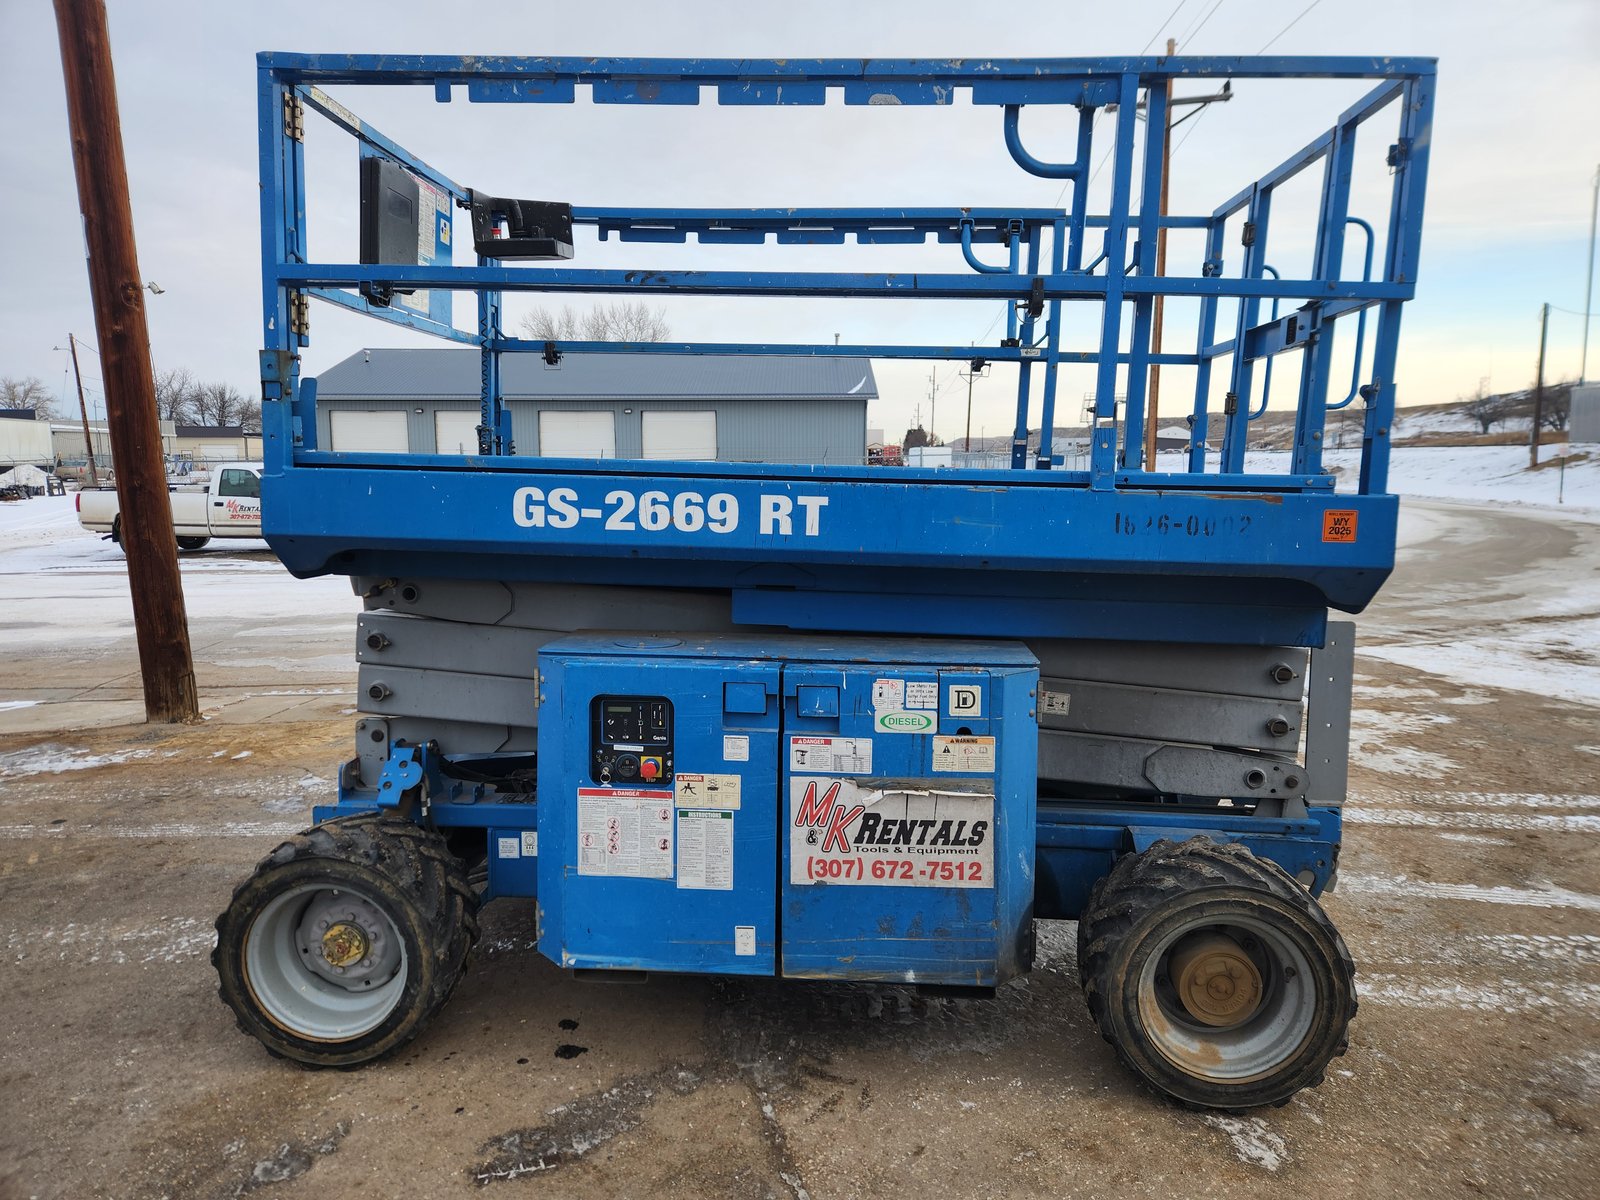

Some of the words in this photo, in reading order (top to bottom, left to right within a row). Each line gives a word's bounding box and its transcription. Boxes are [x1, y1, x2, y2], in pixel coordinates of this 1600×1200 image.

[512, 486, 740, 534] GS-2669
[758, 494, 830, 536] RT
[1333, 517, 1350, 526] WY
[1328, 526, 1352, 535] 2025
[954, 690, 976, 709] D
[888, 717, 924, 726] DIESEL
[854, 812, 988, 847] RENTALS
[854, 846, 889, 854] Tools
[894, 846, 903, 854] &
[908, 847, 979, 856] Equipment
[806, 856, 863, 880] (307)
